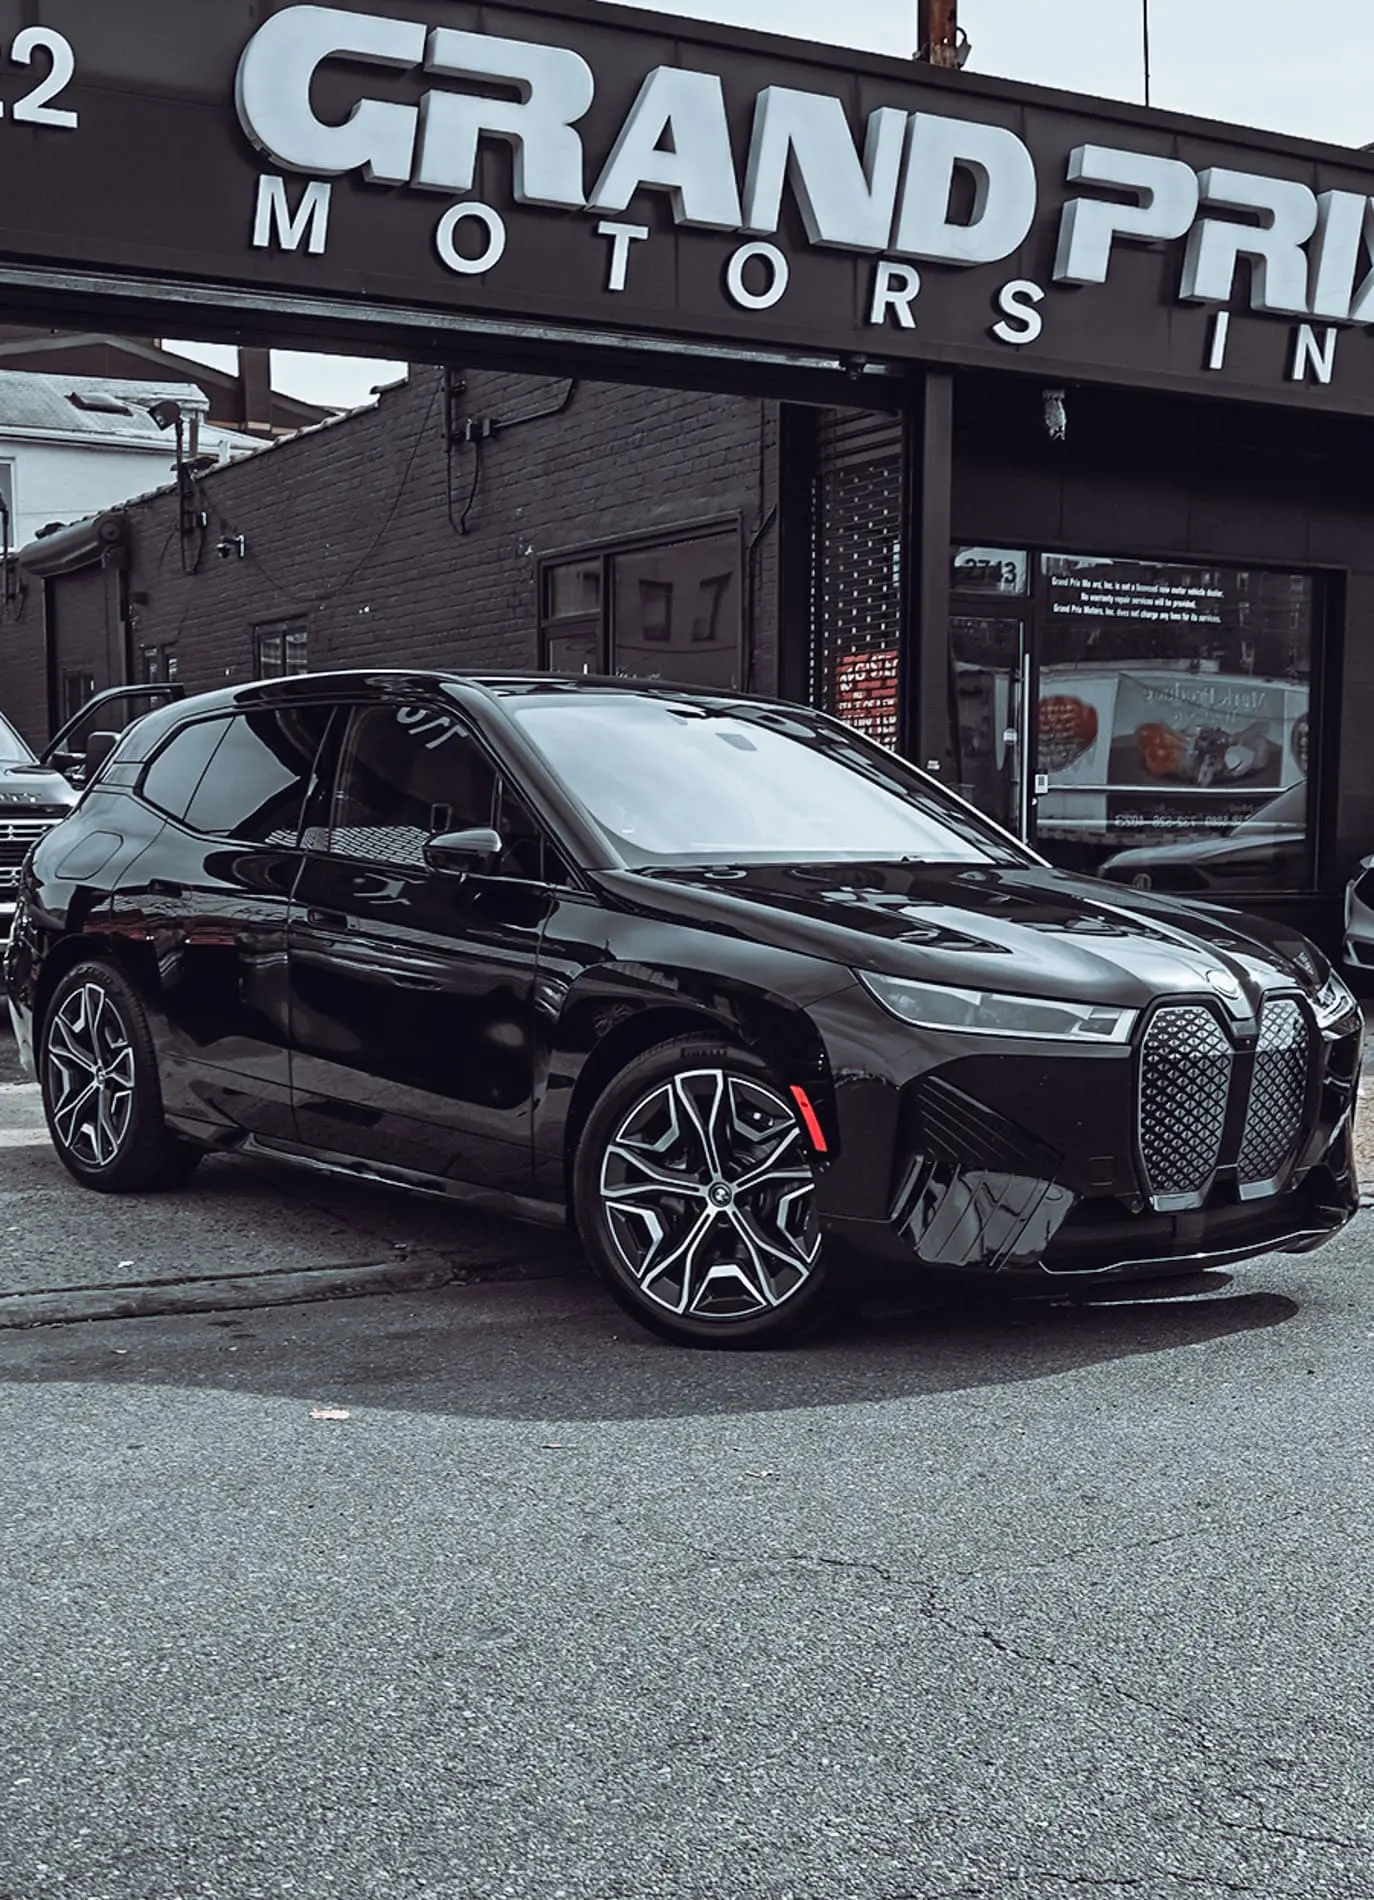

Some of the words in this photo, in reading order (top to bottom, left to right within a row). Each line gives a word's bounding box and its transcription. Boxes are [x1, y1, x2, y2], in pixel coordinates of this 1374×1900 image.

[0, 25, 78, 129] 2
[235, 4, 1038, 267] GRAND
[1053, 143, 1374, 325] PRI
[252, 173, 1046, 345] MOTORS
[1051, 576, 1069, 586] Grand
[1070, 577, 1081, 587] Prix
[1115, 581, 1120, 590] is
[1121, 582, 1131, 591] not
[1131, 584, 1135, 592] a
[1187, 588, 1206, 596] vehicle
[1053, 603, 1071, 613] Grand
[1071, 604, 1082, 614] Prix
[1116, 608, 1130, 617] does
[1130, 609, 1140, 618] not
[1140, 610, 1159, 620] charge
[1159, 612, 1169, 621] any
[1081, 592, 1089, 601] No
[1090, 594, 1114, 604] warranty
[1114, 595, 1131, 604] repair
[1131, 597, 1154, 606] services
[1154, 597, 1164, 606] will
[1165, 599, 1172, 607] be
